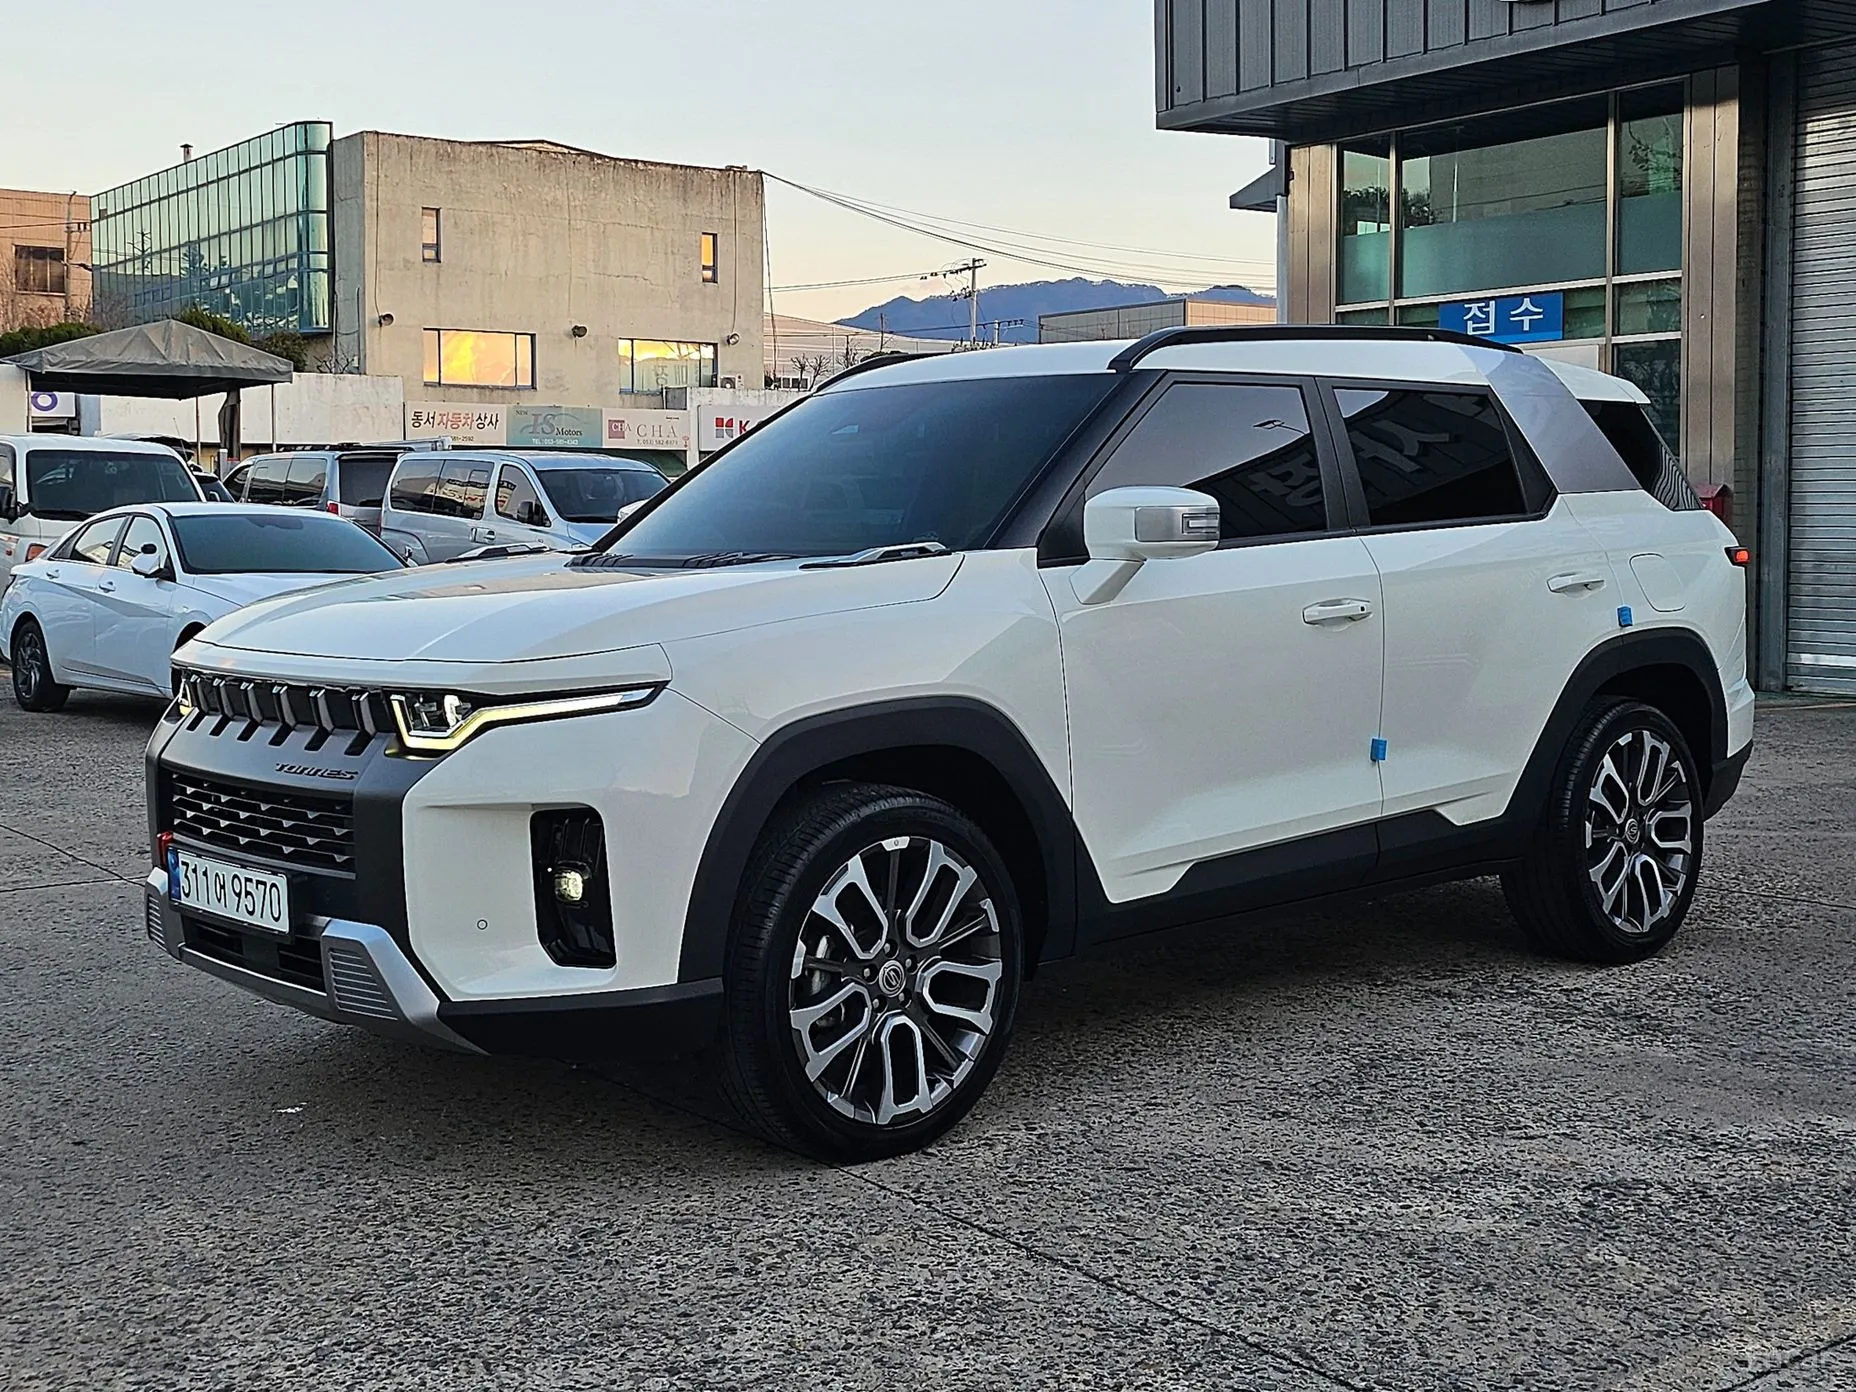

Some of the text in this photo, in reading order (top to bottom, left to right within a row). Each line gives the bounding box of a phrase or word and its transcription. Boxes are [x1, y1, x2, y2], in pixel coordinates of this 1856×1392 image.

[1463, 297, 1544, 335] 접수
[412, 411, 499, 430] 동서 자동차 상사
[556, 426, 583, 437] Motors
[637, 424, 679, 438] CHA
